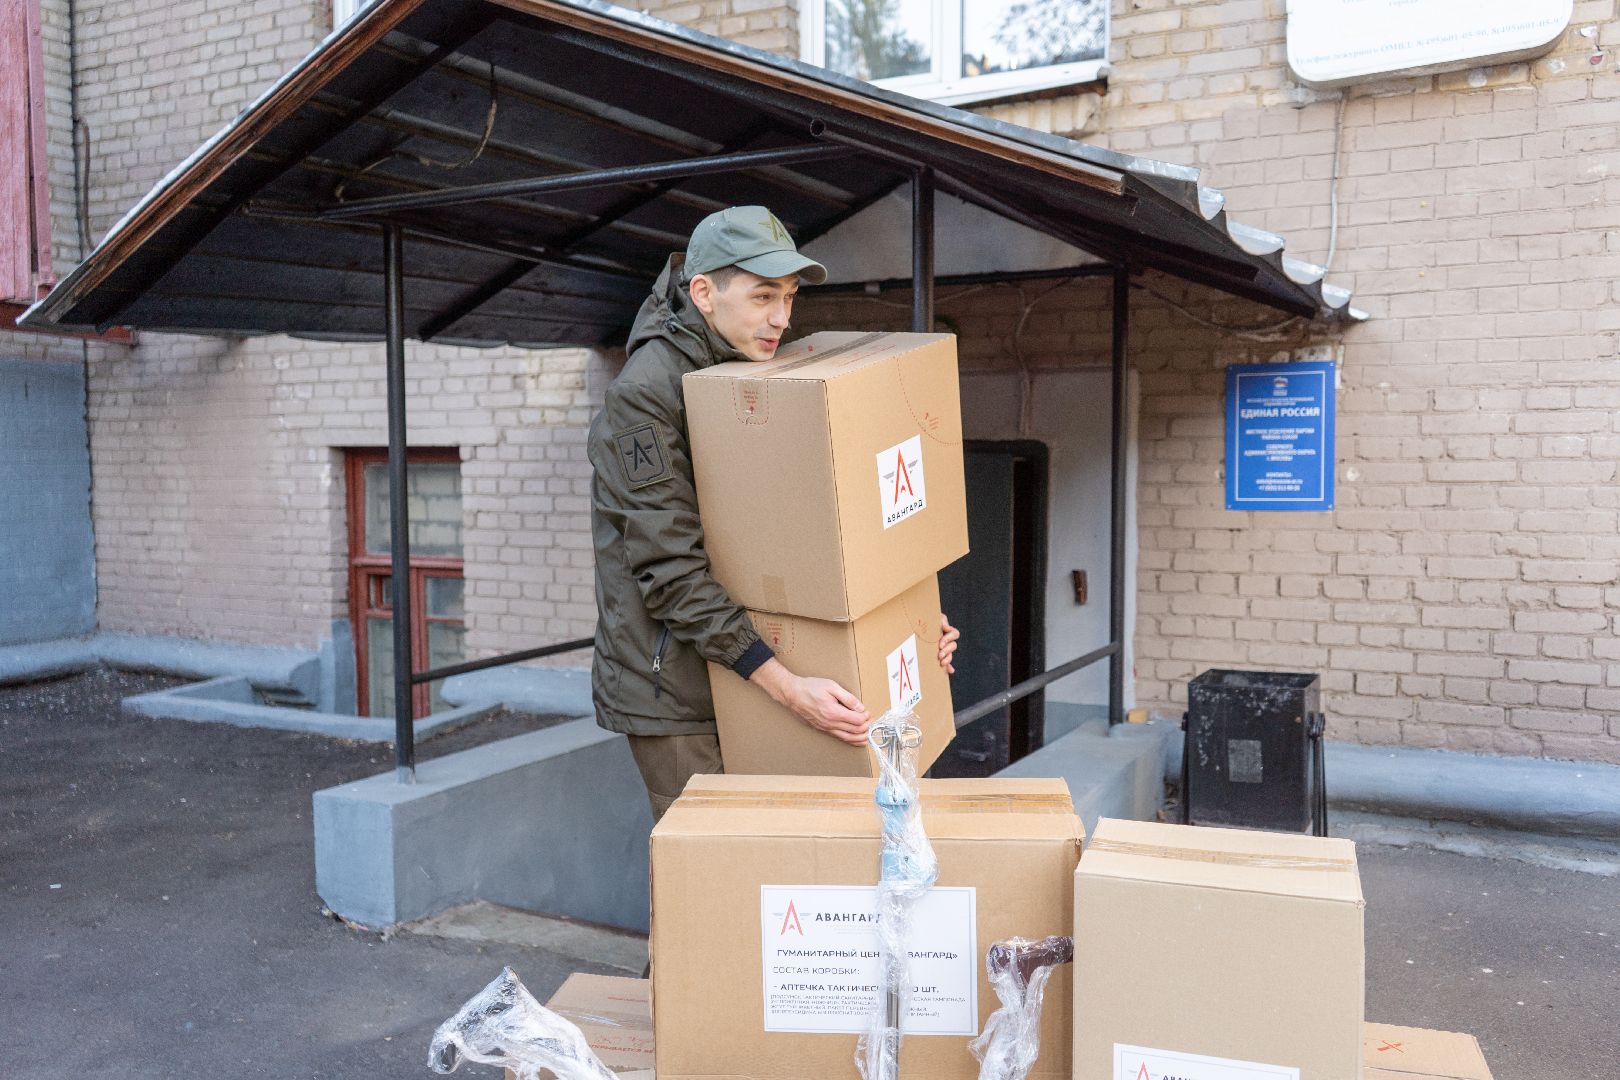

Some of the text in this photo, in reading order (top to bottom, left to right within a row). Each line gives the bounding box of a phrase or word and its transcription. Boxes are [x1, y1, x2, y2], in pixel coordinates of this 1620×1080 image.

[1241, 406, 1320, 418] ЕДИНАЯ РОССИЯ
[887, 499, 923, 523] АВАНГАРД
[777, 948, 858, 958] ГУМАНИТАРНЫЙ
[860, 951, 880, 959] ЦЕН
[772, 966, 860, 976] СОСТАВ КОРОБКИ:
[780, 983, 825, 992] АПТЕЧКА
[827, 984, 879, 993] ТАКТИЧЕС
